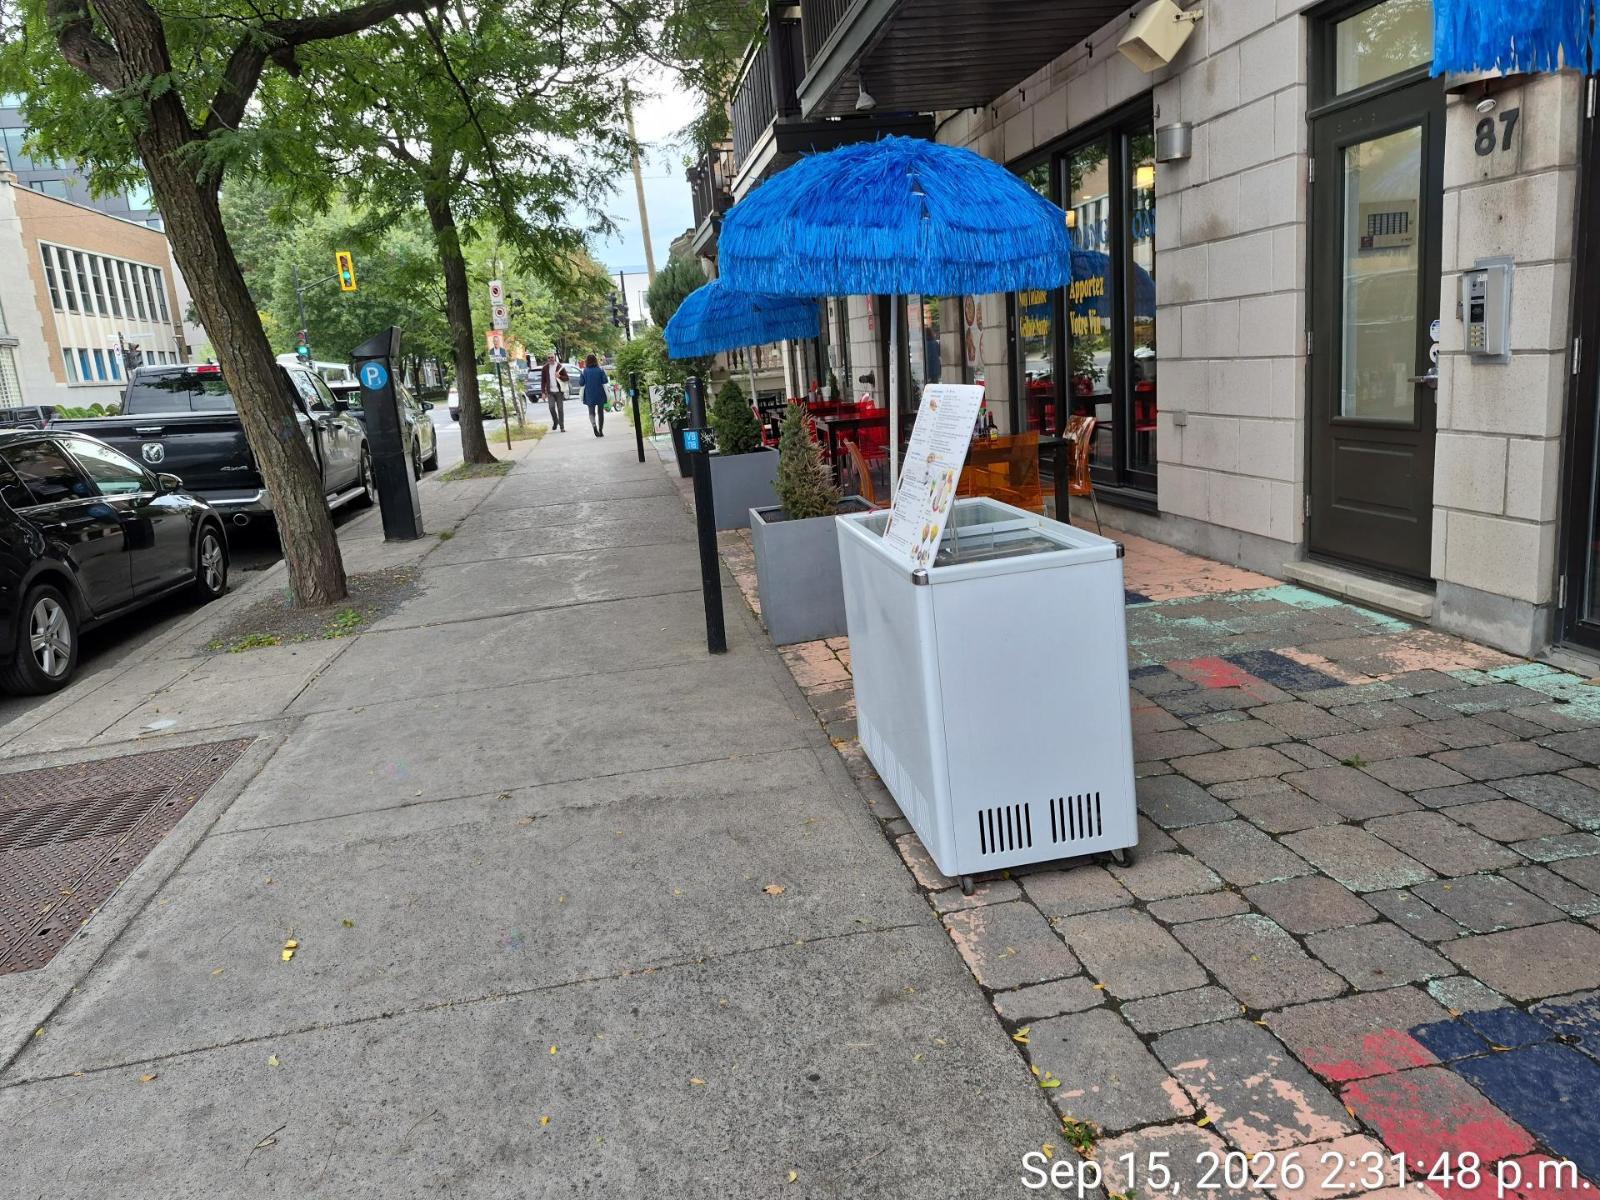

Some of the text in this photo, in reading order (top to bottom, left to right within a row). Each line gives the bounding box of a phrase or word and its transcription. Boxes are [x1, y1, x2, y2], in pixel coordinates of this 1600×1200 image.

[1475, 108, 1519, 156] 87
[1069, 275, 1104, 304] Apportez
[1069, 311, 1088, 335] Votre
[1088, 309, 1101, 335] Vin
